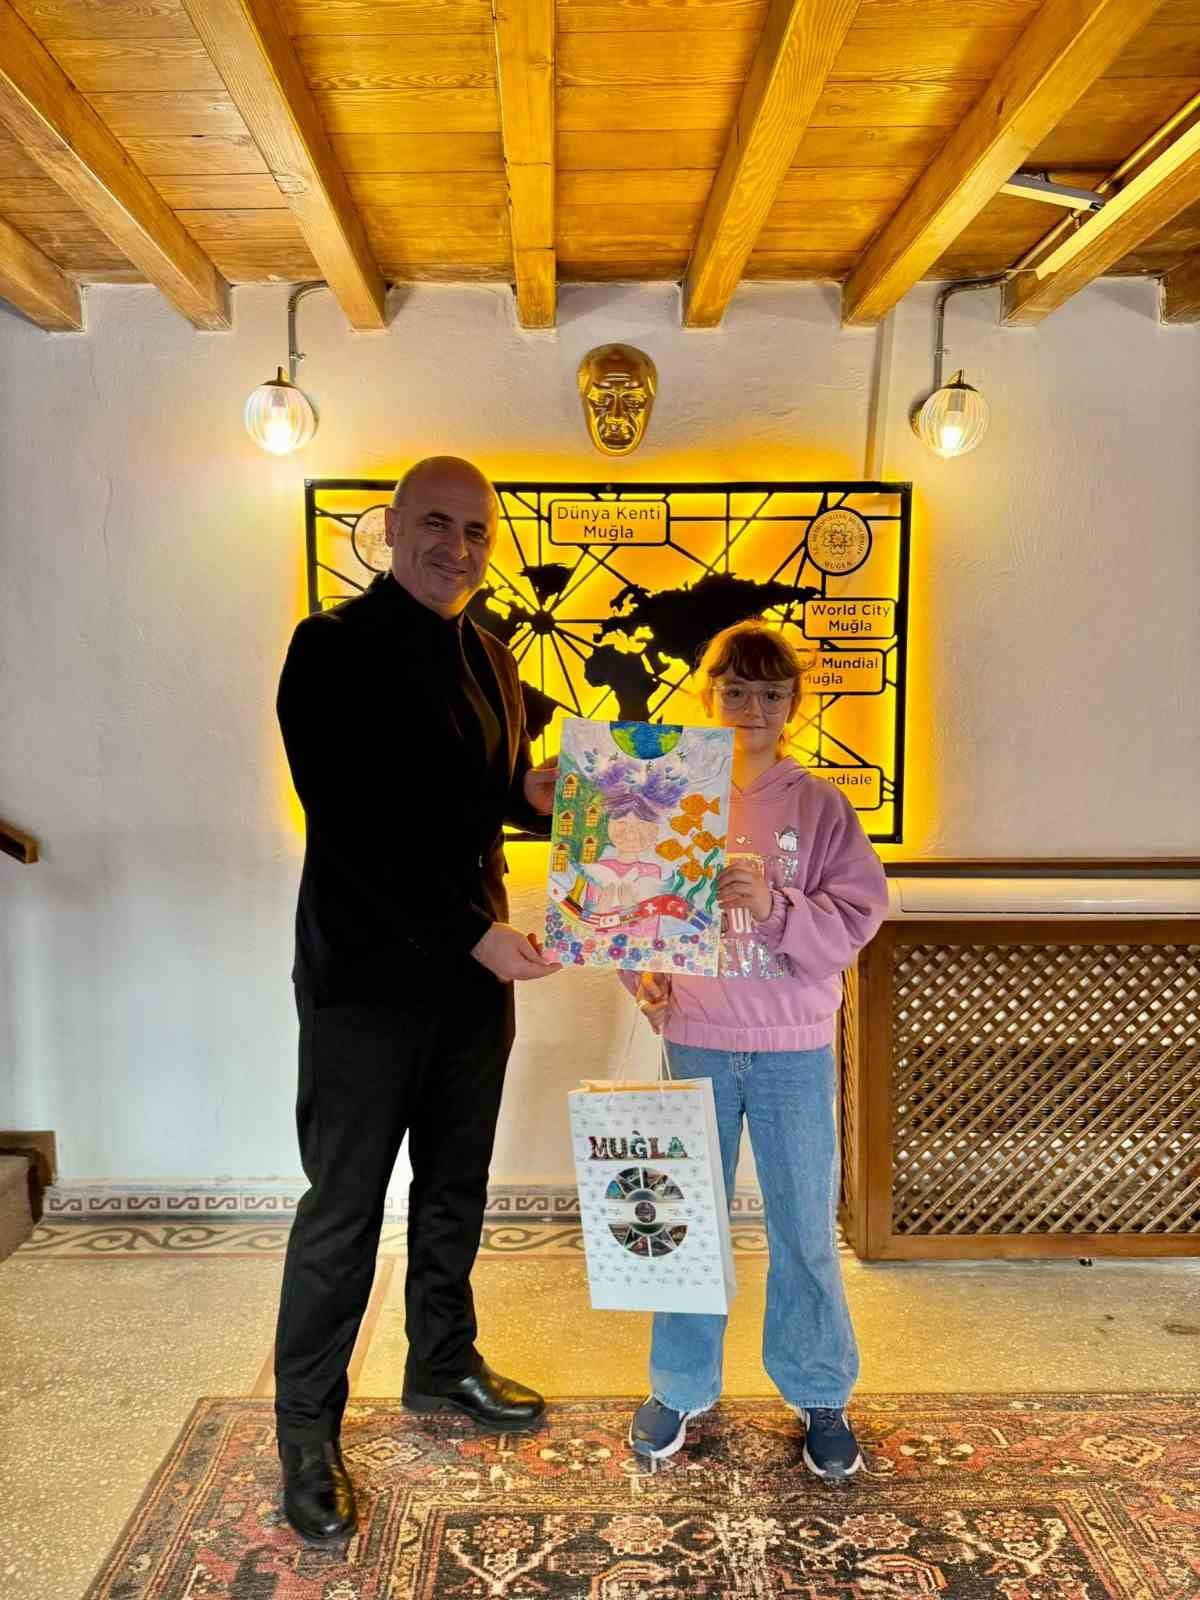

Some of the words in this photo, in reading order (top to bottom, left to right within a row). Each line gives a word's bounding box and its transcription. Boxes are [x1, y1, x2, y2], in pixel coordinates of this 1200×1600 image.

[557, 506, 610, 522] Dünya
[617, 505, 661, 520] Kenti
[583, 525, 634, 541] Muğla
[811, 604, 857, 616] World
[862, 604, 890, 618] City
[828, 619, 872, 634] Muğla
[821, 657, 878, 669] Mundial
[825, 773, 872, 785] ndiale
